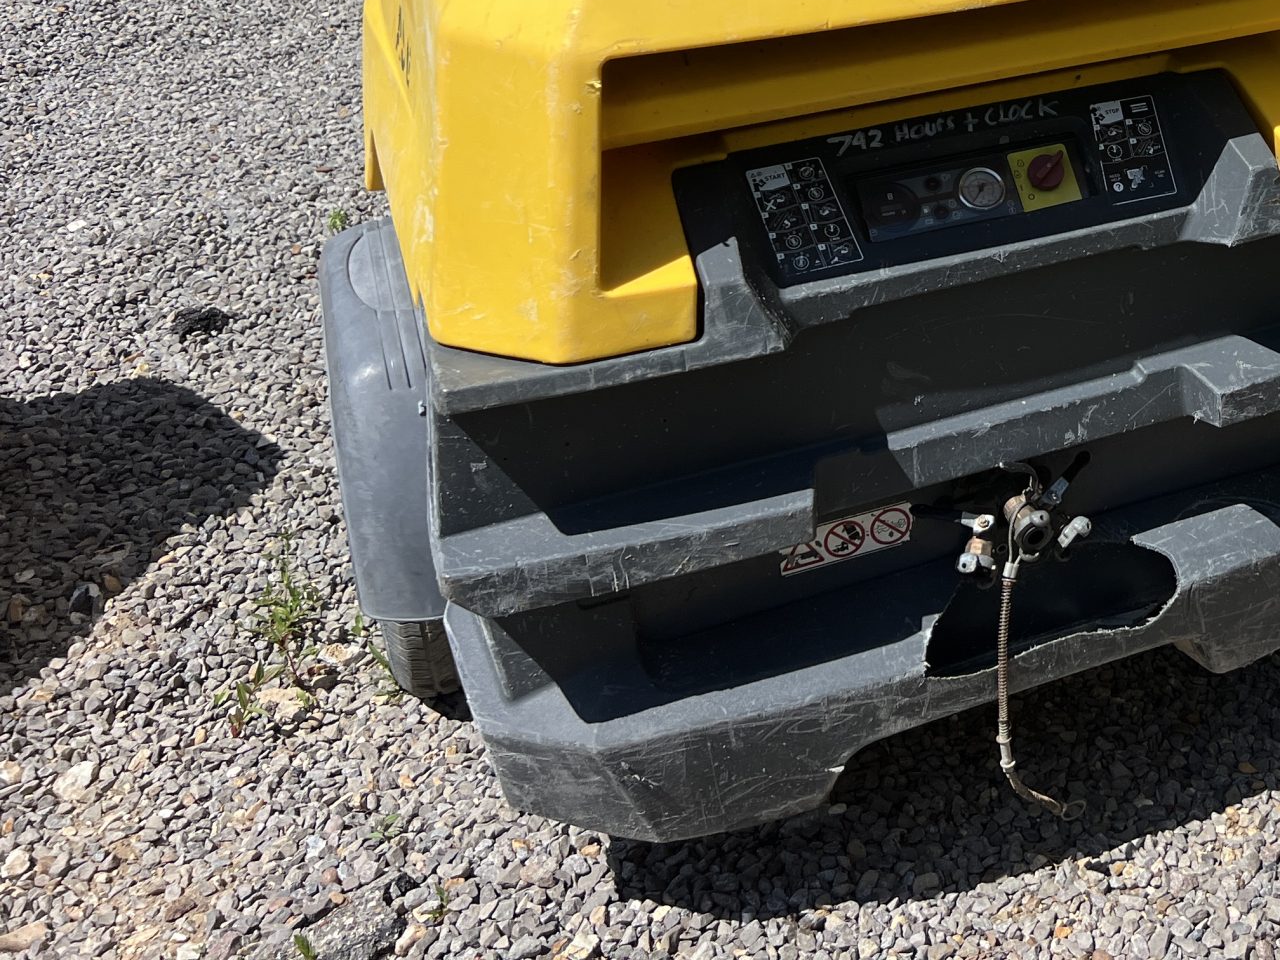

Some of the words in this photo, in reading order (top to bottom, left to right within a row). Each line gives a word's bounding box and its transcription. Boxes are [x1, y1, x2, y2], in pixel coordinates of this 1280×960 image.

[1104, 107, 1120, 115] STOP
[826, 129, 885, 158] 742
[961, 111, 980, 133] +
[984, 97, 1060, 127] CLOCK
[765, 172, 786, 182] START
